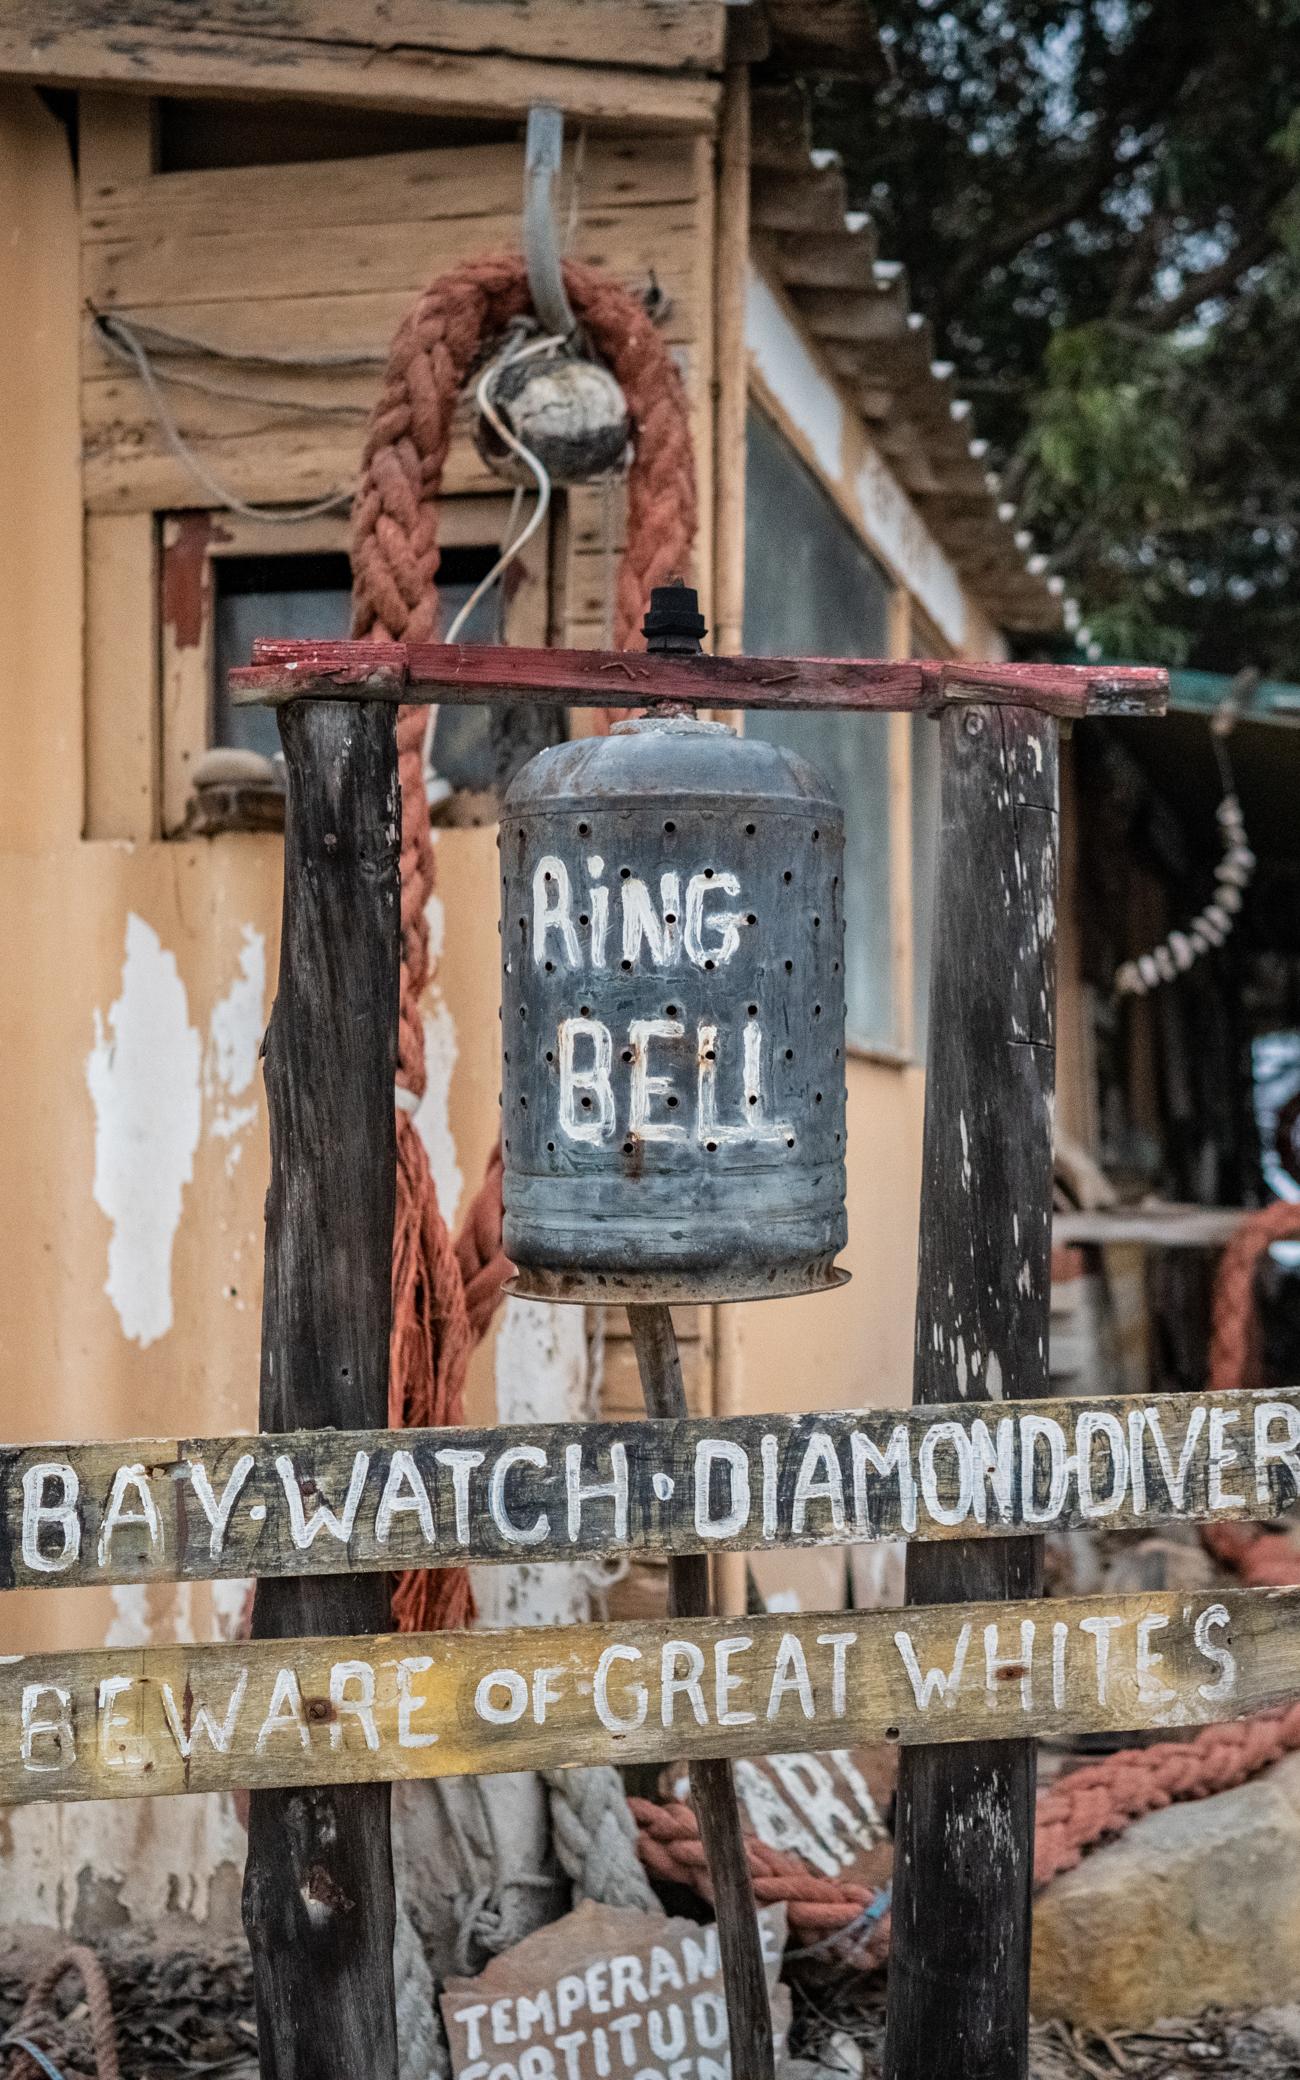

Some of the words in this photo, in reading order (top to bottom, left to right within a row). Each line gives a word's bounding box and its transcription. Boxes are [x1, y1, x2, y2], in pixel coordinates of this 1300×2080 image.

[558, 1015, 795, 1146] BELL
[19, 1656, 440, 1774] BEWARE
[473, 1666, 567, 1726] OF
[592, 1631, 857, 1734] GREAT
[453, 1908, 783, 2061] TEMPERANE
